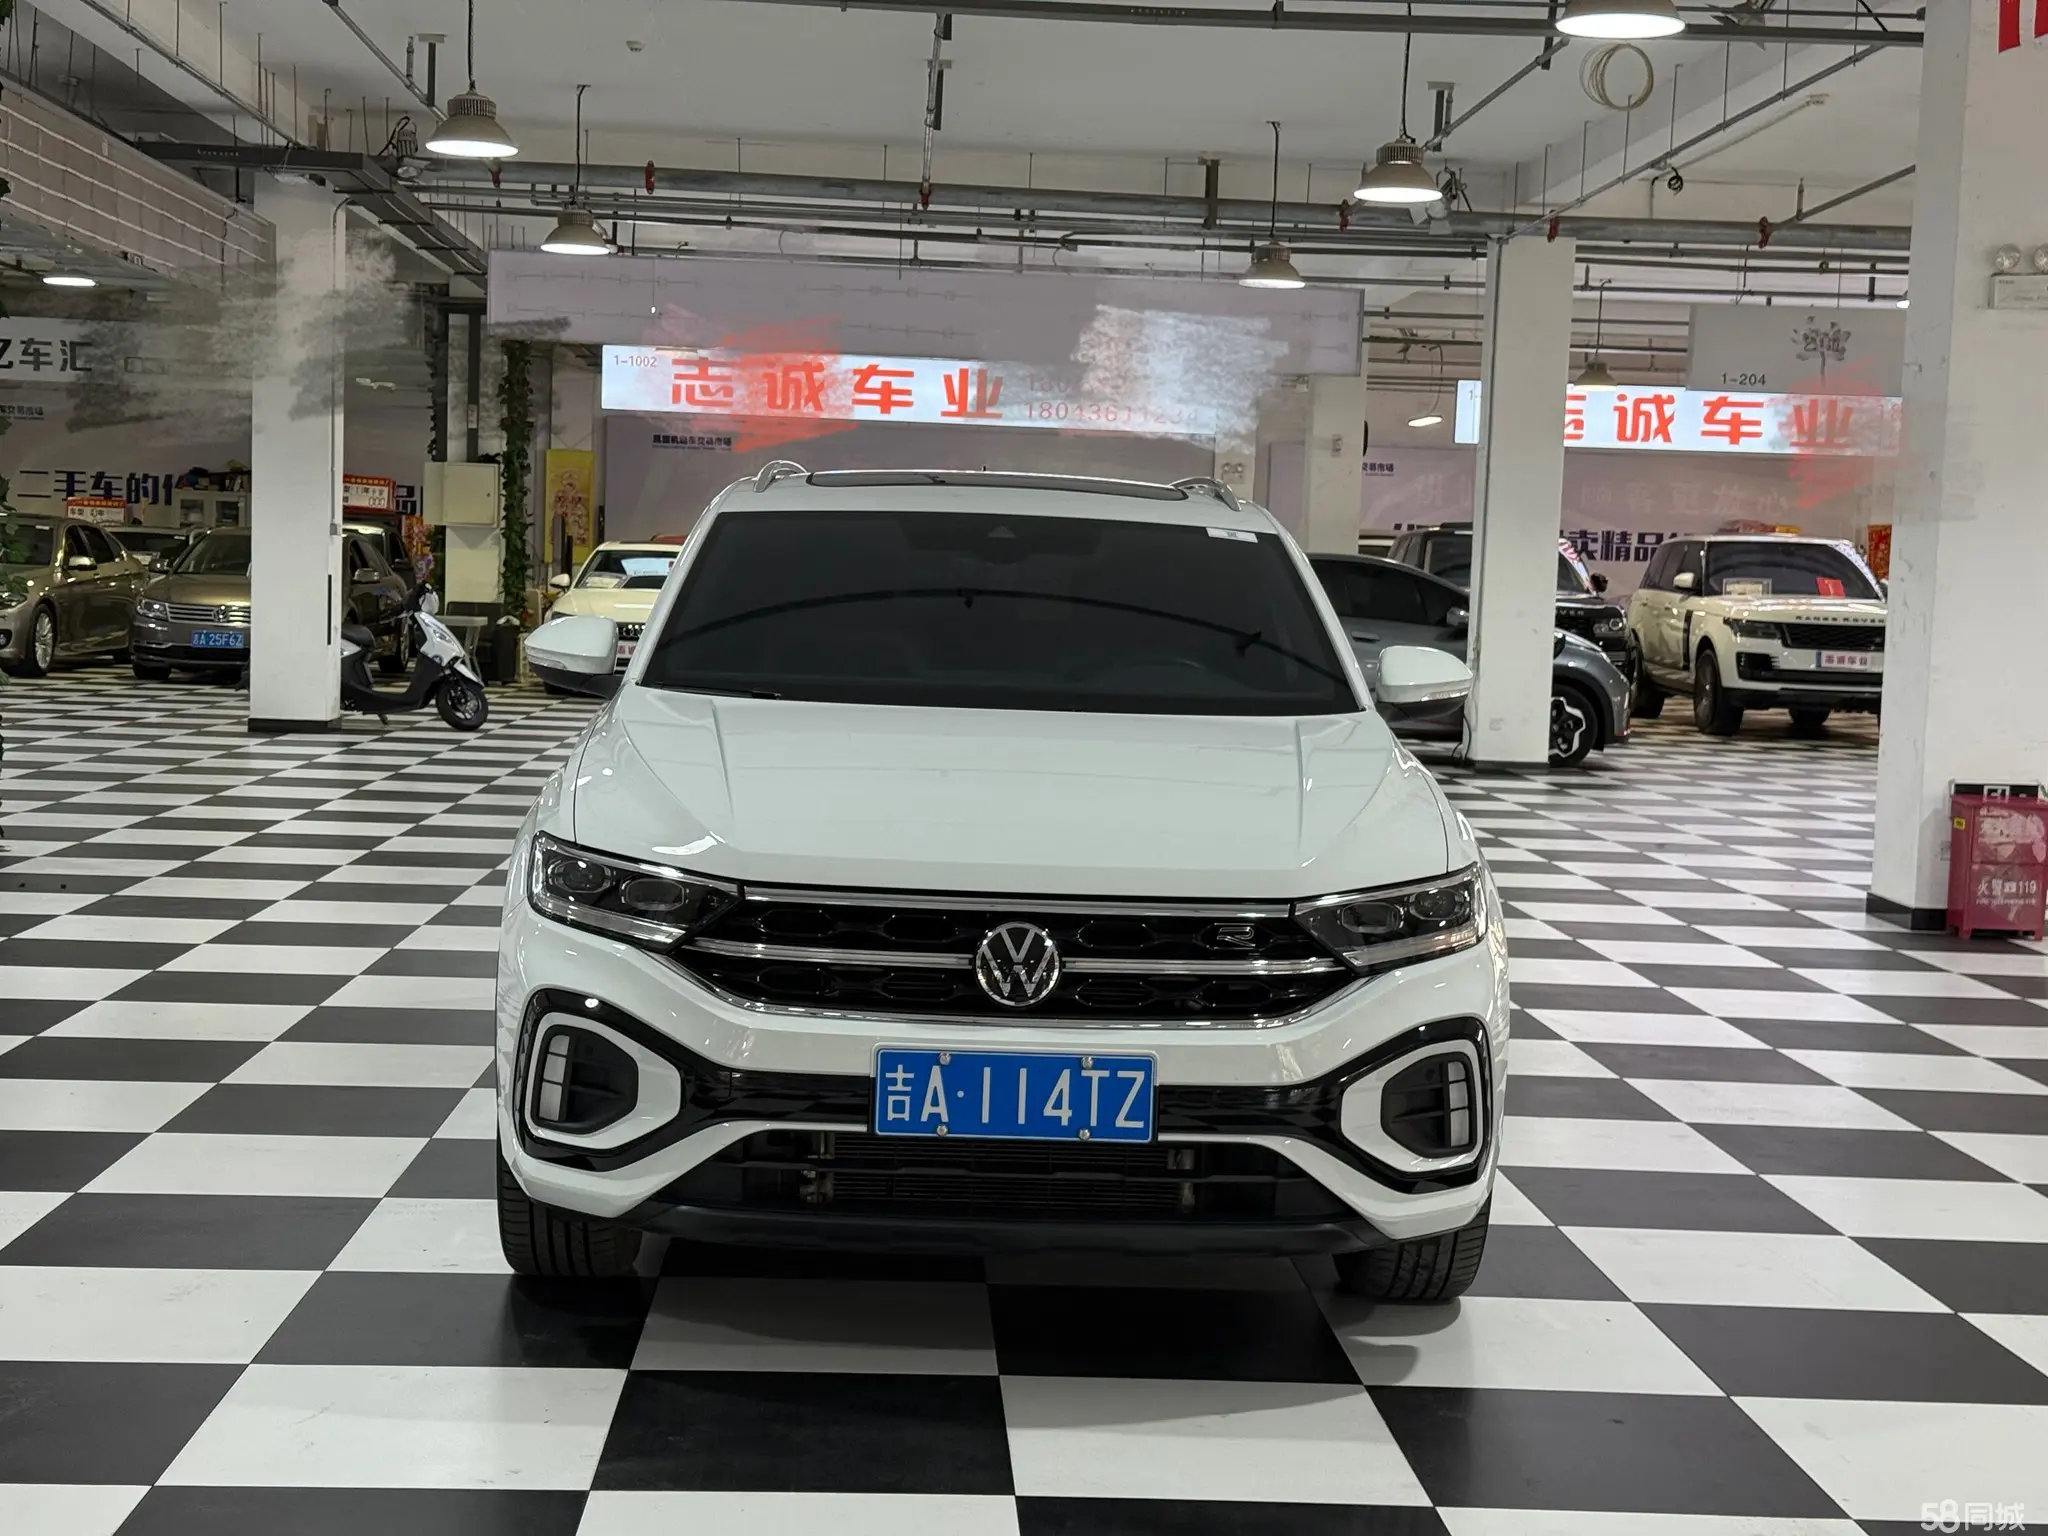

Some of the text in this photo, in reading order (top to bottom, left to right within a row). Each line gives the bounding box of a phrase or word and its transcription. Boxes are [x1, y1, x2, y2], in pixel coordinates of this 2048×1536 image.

[614, 355, 657, 368] 1-1002
[672, 357, 1003, 419] 志诚车业
[1721, 373, 1766, 386] 1-204
[1560, 529, 1690, 562] 卖精品
[2019, 880, 2037, 894] 119
[885, 1064, 1145, 1128] 吉A·114TZ
